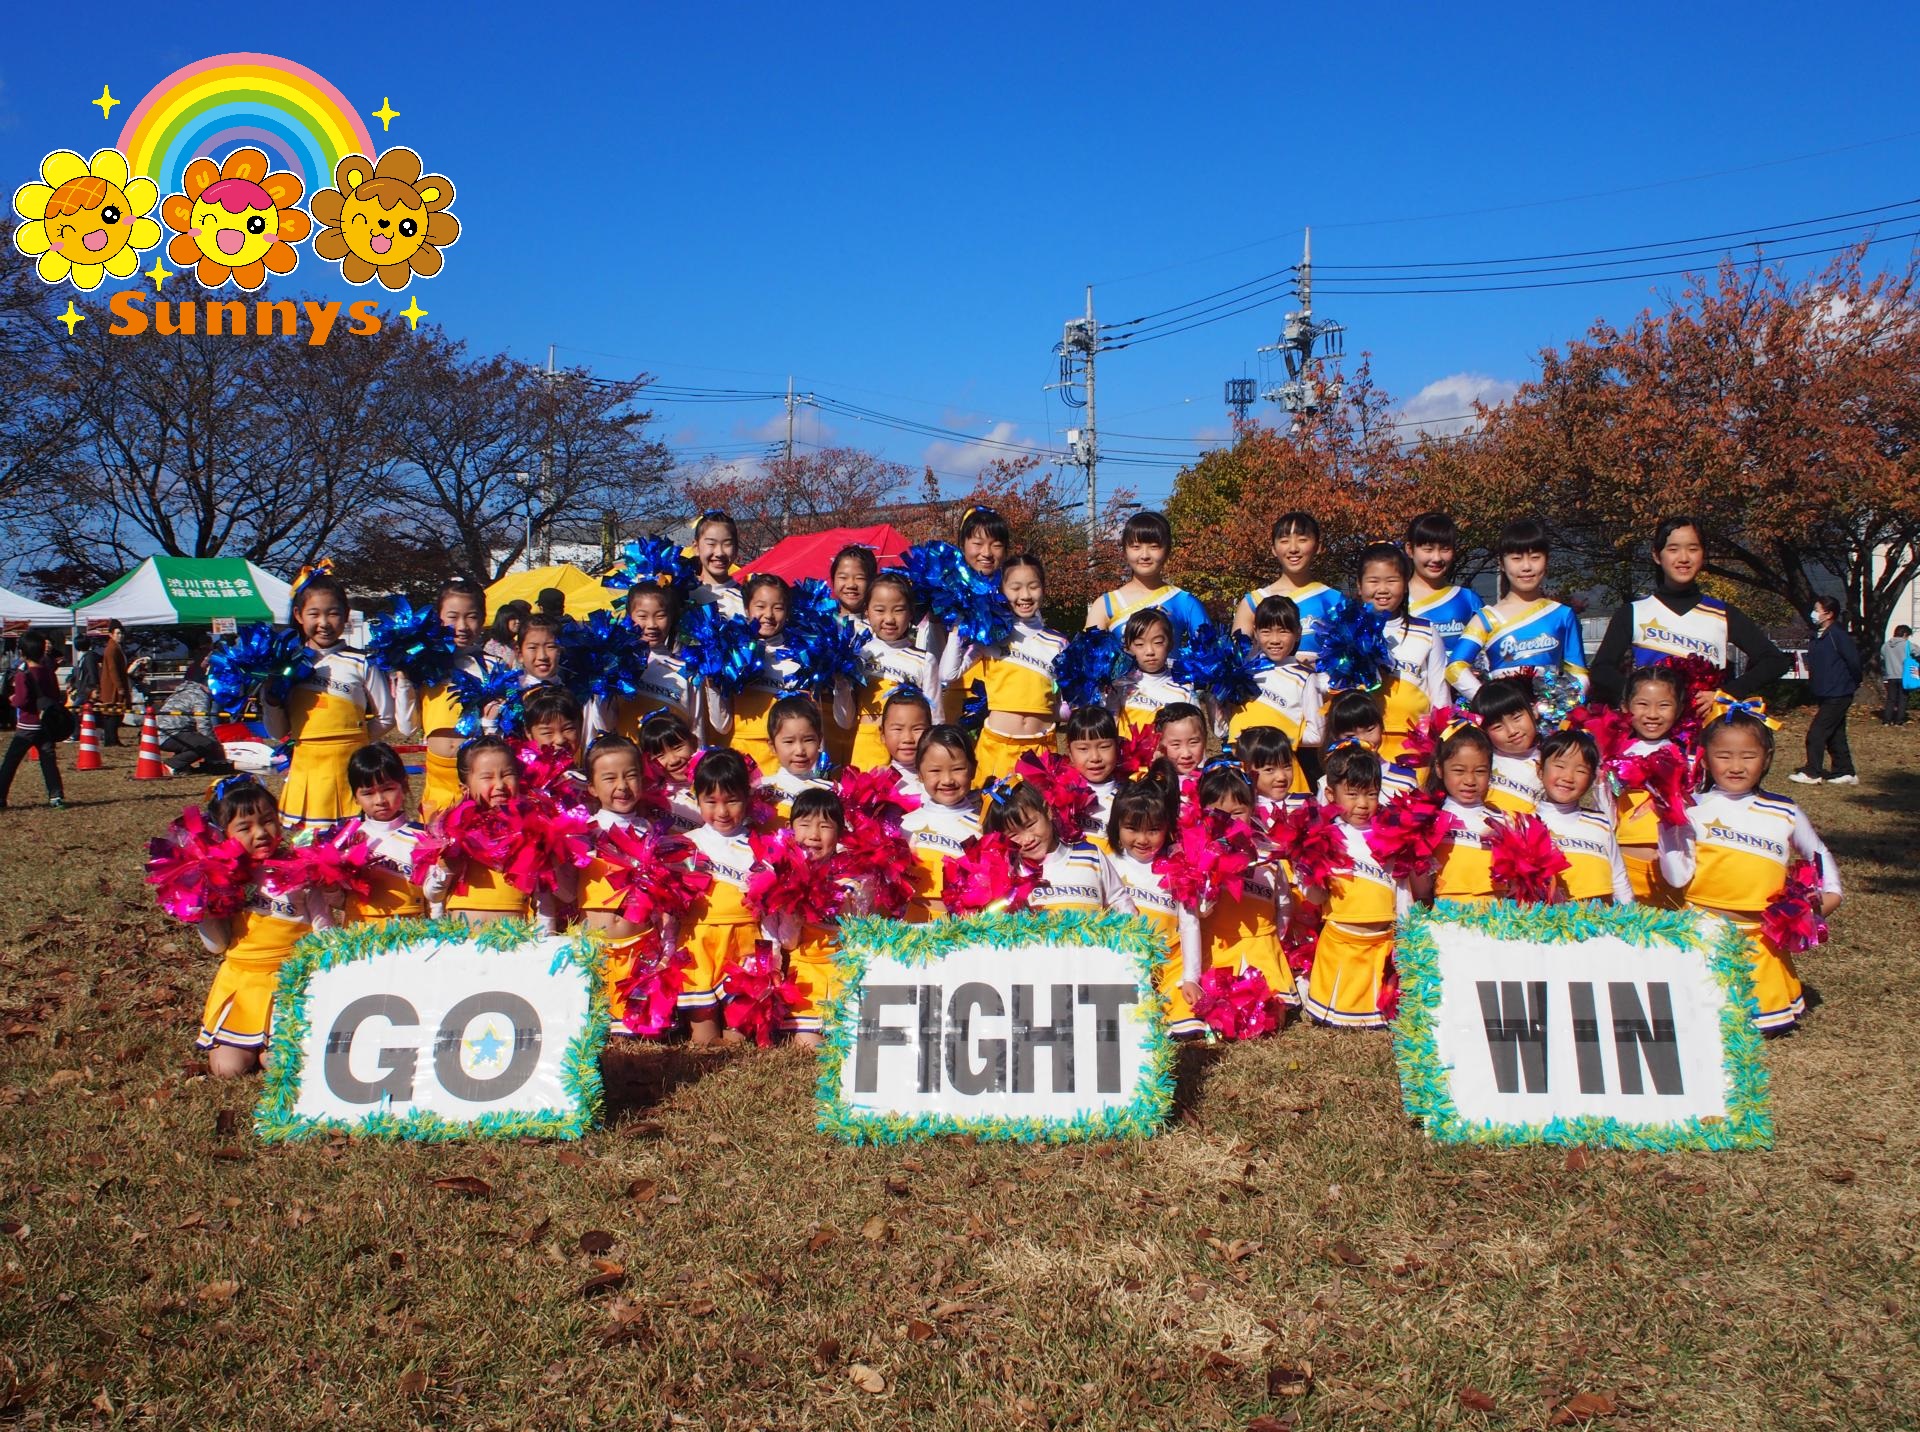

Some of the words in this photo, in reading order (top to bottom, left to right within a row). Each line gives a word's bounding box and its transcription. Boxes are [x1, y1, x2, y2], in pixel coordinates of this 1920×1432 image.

[167, 578, 249, 588] 渋川市社会
[171, 588, 253, 598] 福祉協議会
[1500, 632, 1559, 660] Bravstar
[1646, 627, 1719, 660] SUNNYS
[919, 832, 963, 852] SUNN
[1711, 827, 1782, 856] SUNNYS
[1033, 886, 1098, 898] SUNNYS
[1125, 886, 1176, 909] UNNYS
[324, 991, 542, 1104] GO
[854, 981, 1139, 1096] FIGHT
[1476, 981, 1684, 1095] WIN
